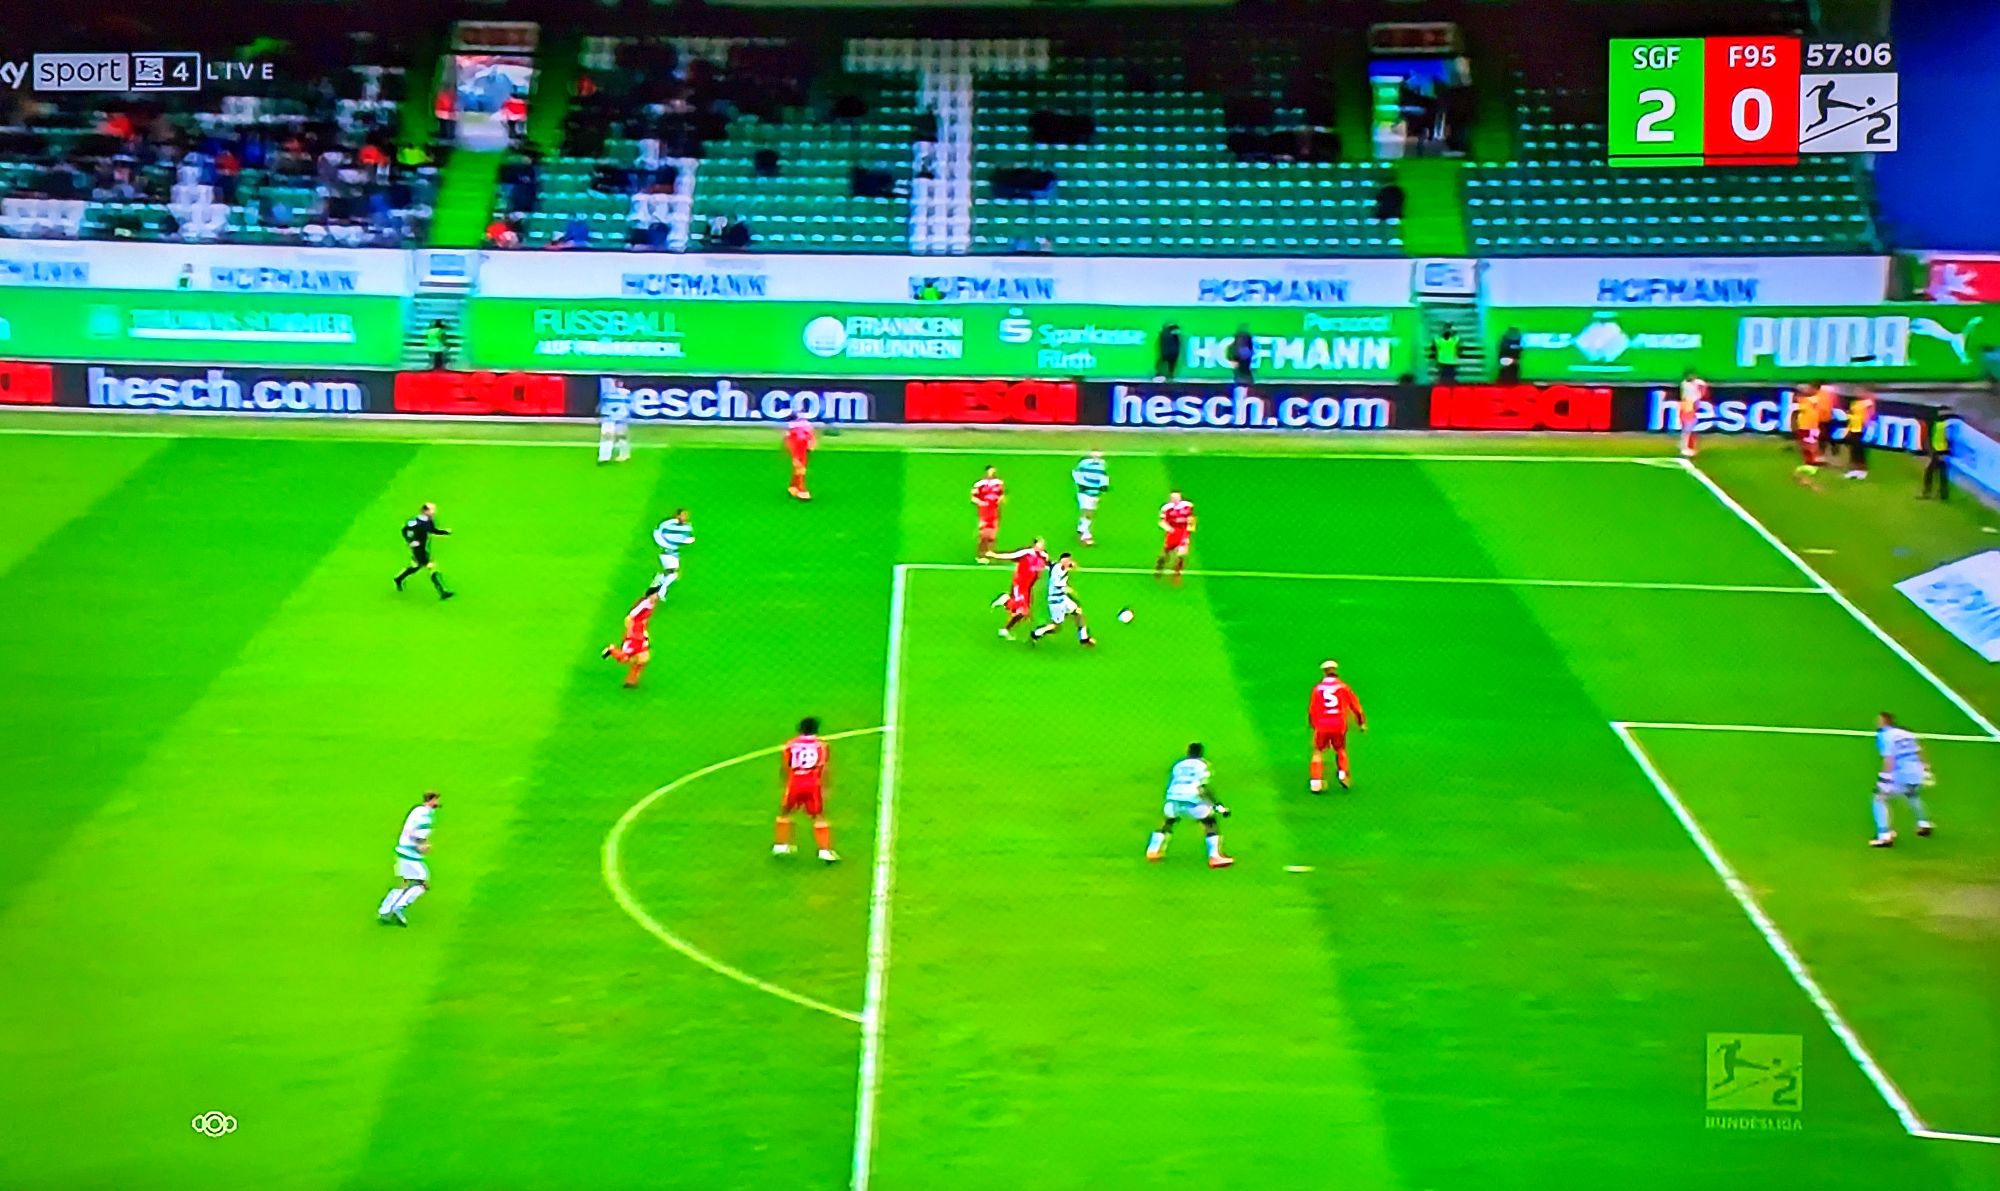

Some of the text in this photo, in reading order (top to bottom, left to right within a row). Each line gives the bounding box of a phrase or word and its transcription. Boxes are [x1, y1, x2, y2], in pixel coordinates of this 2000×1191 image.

[1633, 46, 1681, 69] SGF
[1728, 45, 1777, 68] F95
[1806, 43, 1892, 67] 57:06
[40, 60, 122, 87] sport
[172, 62, 189, 81] 4
[206, 63, 275, 80] LIVE
[1636, 90, 1676, 142] 2
[1731, 88, 1773, 141] 0
[534, 308, 685, 337] FUSSBALL
[1737, 316, 1910, 367] PUMA
[87, 366, 362, 411] hesch.com
[1112, 385, 1390, 428] hesch.com
